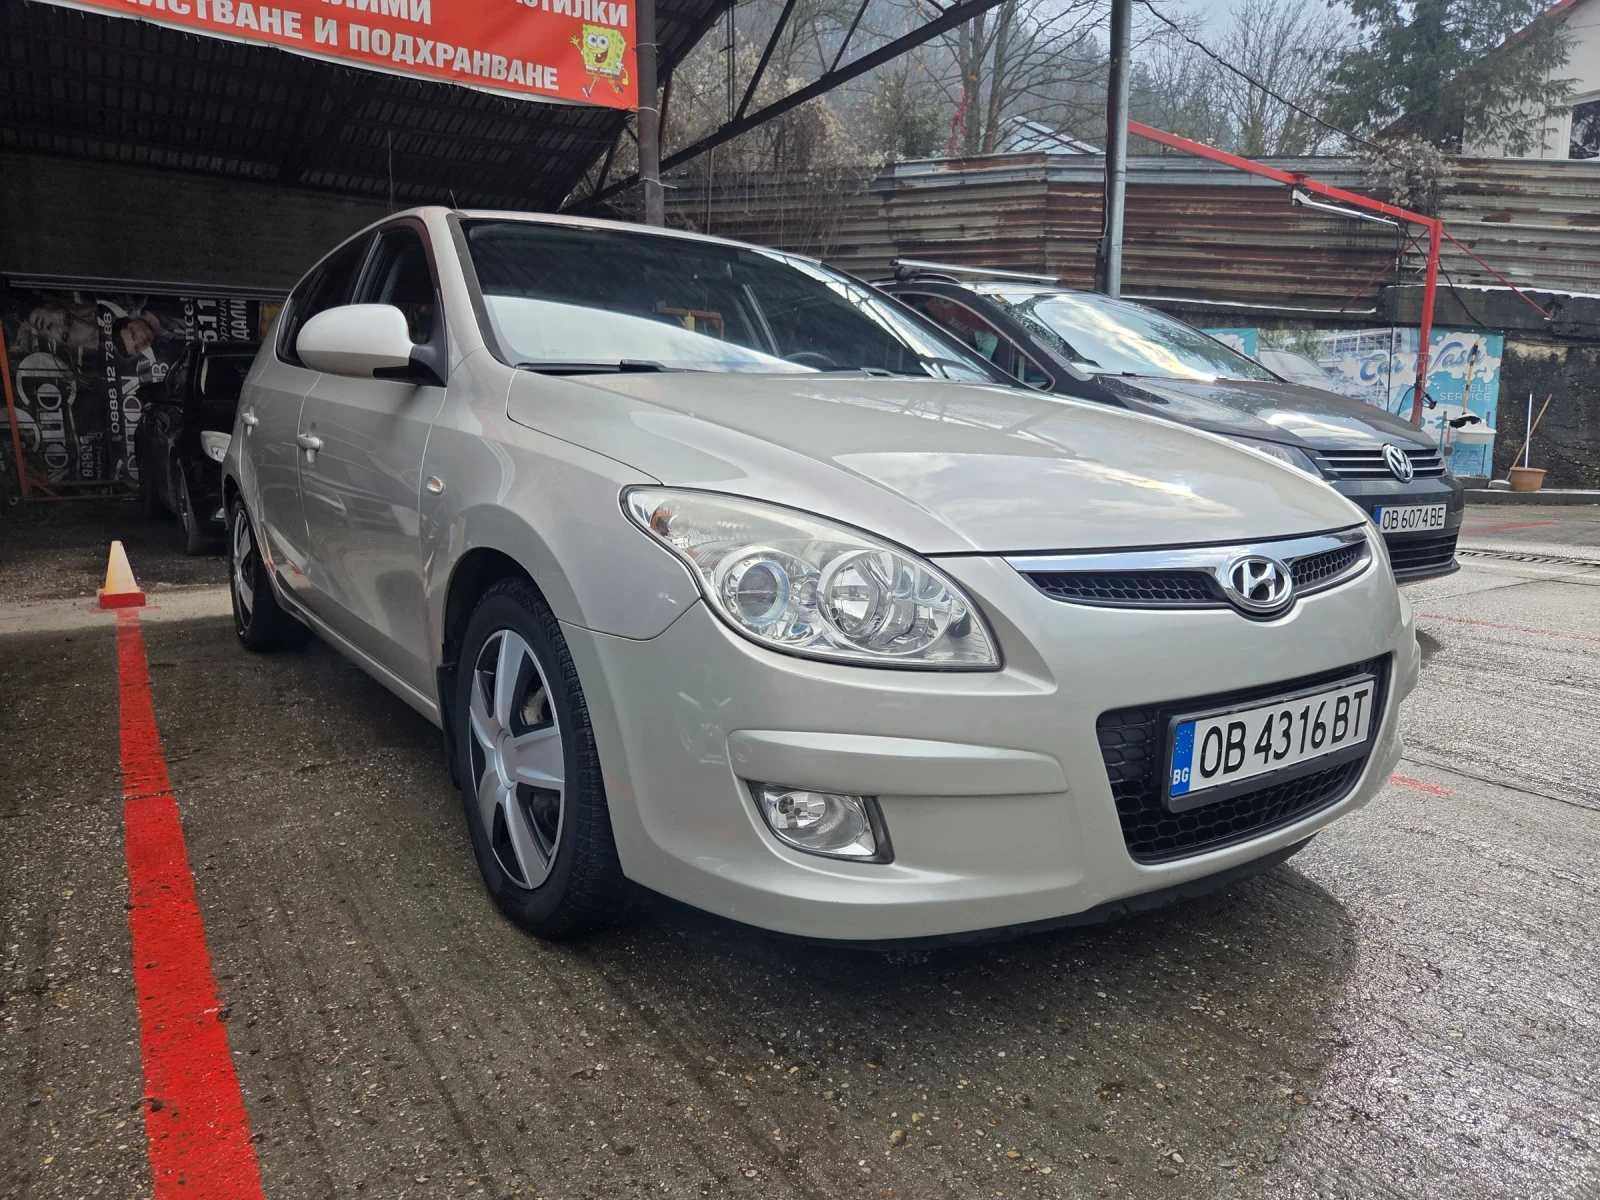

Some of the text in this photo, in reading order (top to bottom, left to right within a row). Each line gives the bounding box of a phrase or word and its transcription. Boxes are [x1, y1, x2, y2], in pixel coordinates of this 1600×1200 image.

[314, 15, 338, 46] И
[349, 23, 560, 90] ПОДХРАНВАНЕ
[104, 341, 115, 361] 73
[1359, 341, 1487, 382] Car Wash
[106, 366, 116, 383] 12
[1439, 392, 1491, 401] SERVICE
[1462, 384, 1492, 392] SELF
[108, 388, 120, 434] 0888
[1401, 508, 1429, 528] 6074
[1200, 689, 1369, 778] OB 4316 BT
[1172, 767, 1189, 785] BG
